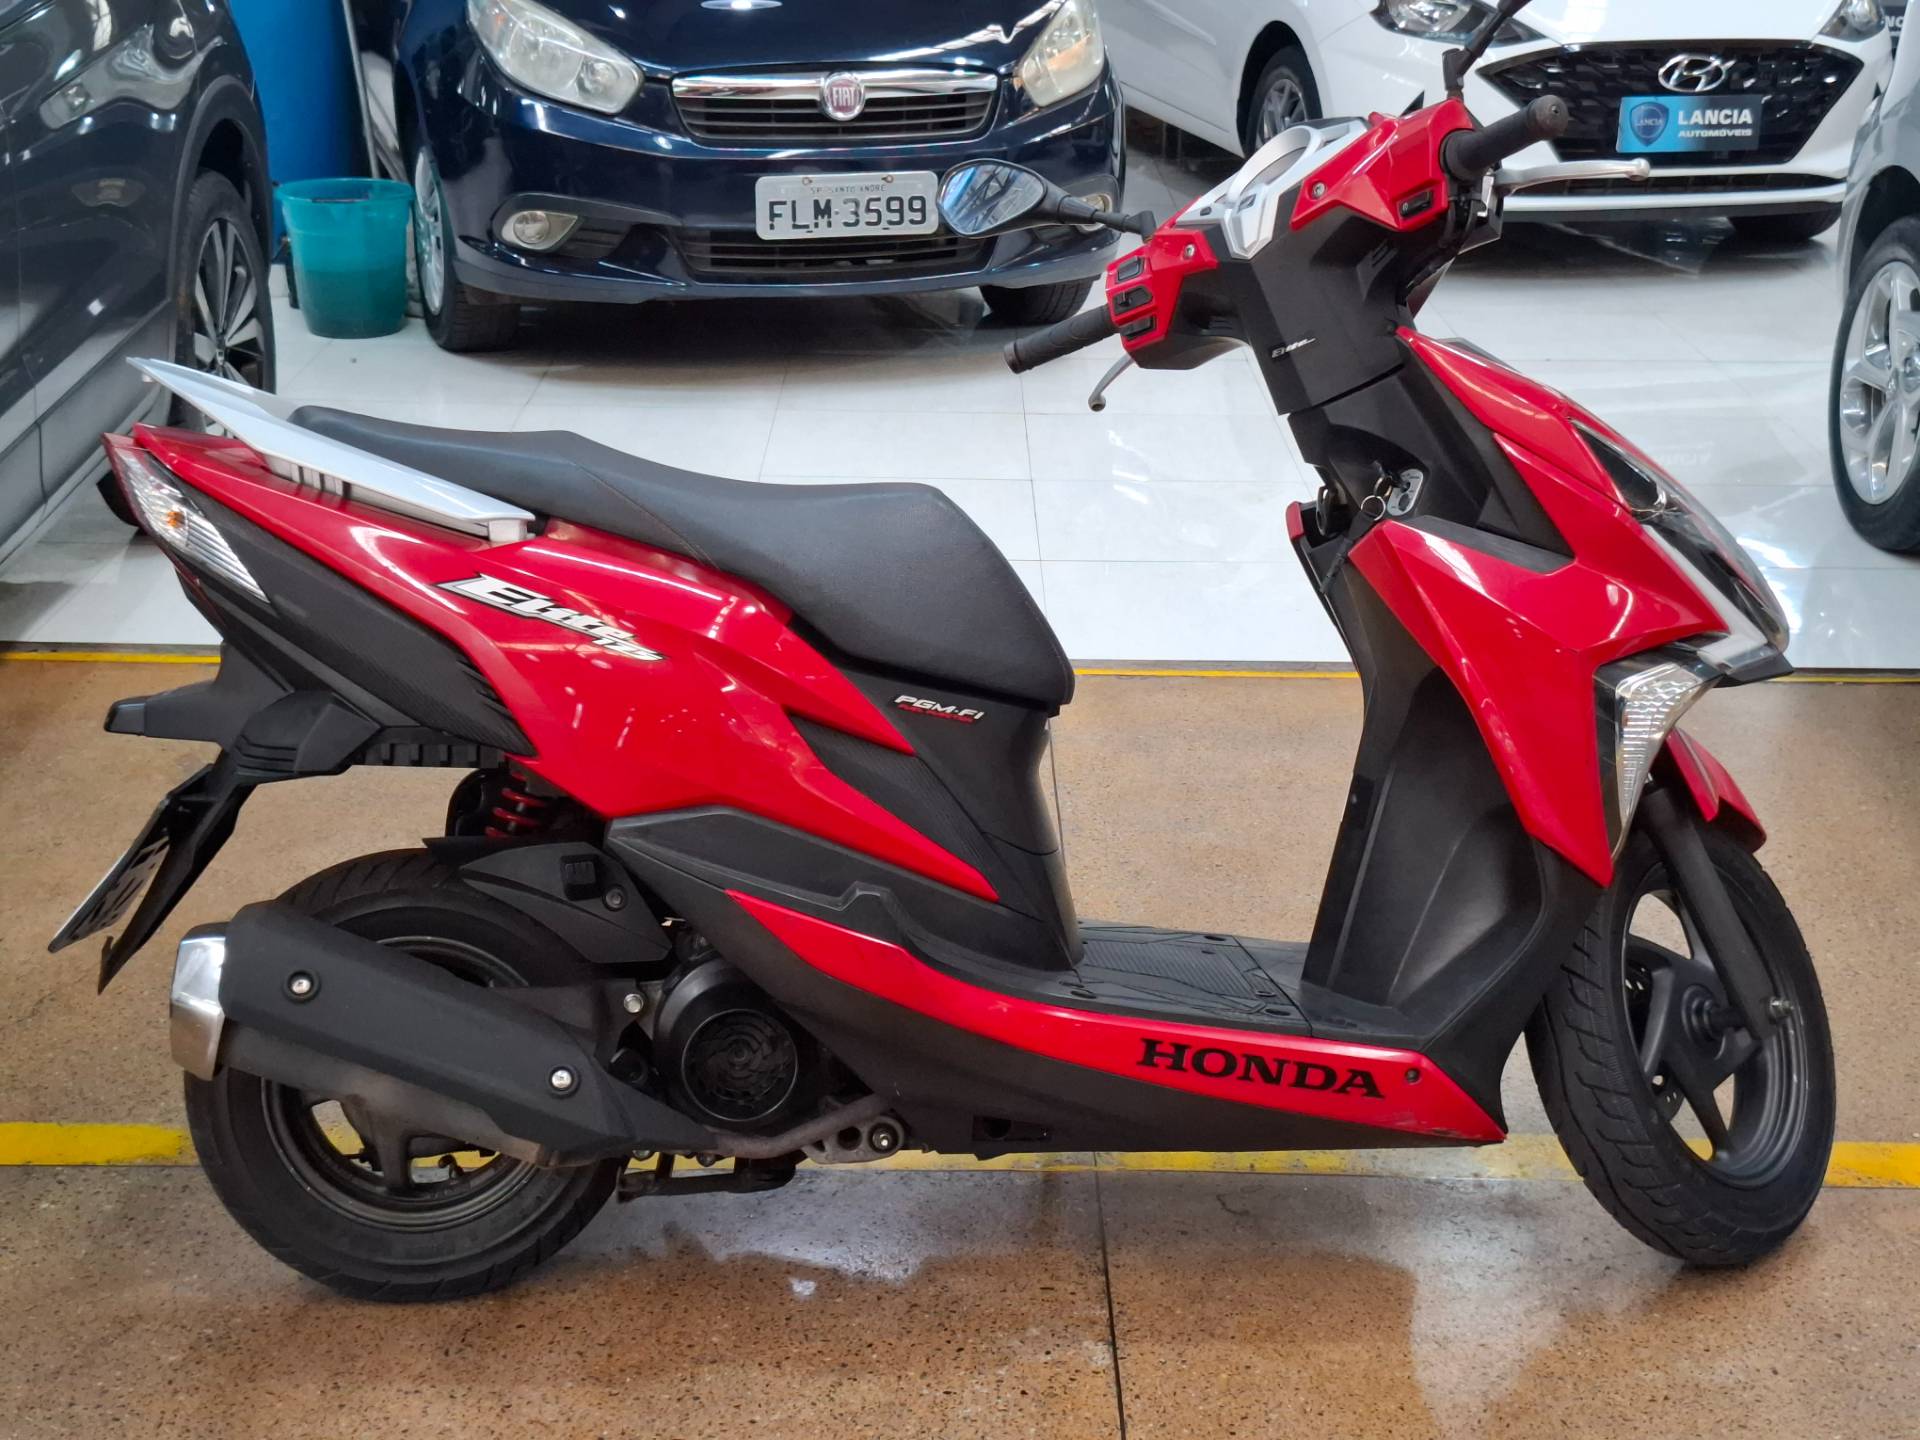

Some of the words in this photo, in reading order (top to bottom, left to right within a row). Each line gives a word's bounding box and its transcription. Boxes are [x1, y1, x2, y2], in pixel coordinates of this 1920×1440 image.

[832, 86, 858, 107] FIAT
[1677, 109, 1753, 125] LANCIA
[1677, 127, 1753, 138] AUTOMÓVEIS
[436, 573, 636, 642] Elite
[1136, 1037, 1386, 1099] HONDA
